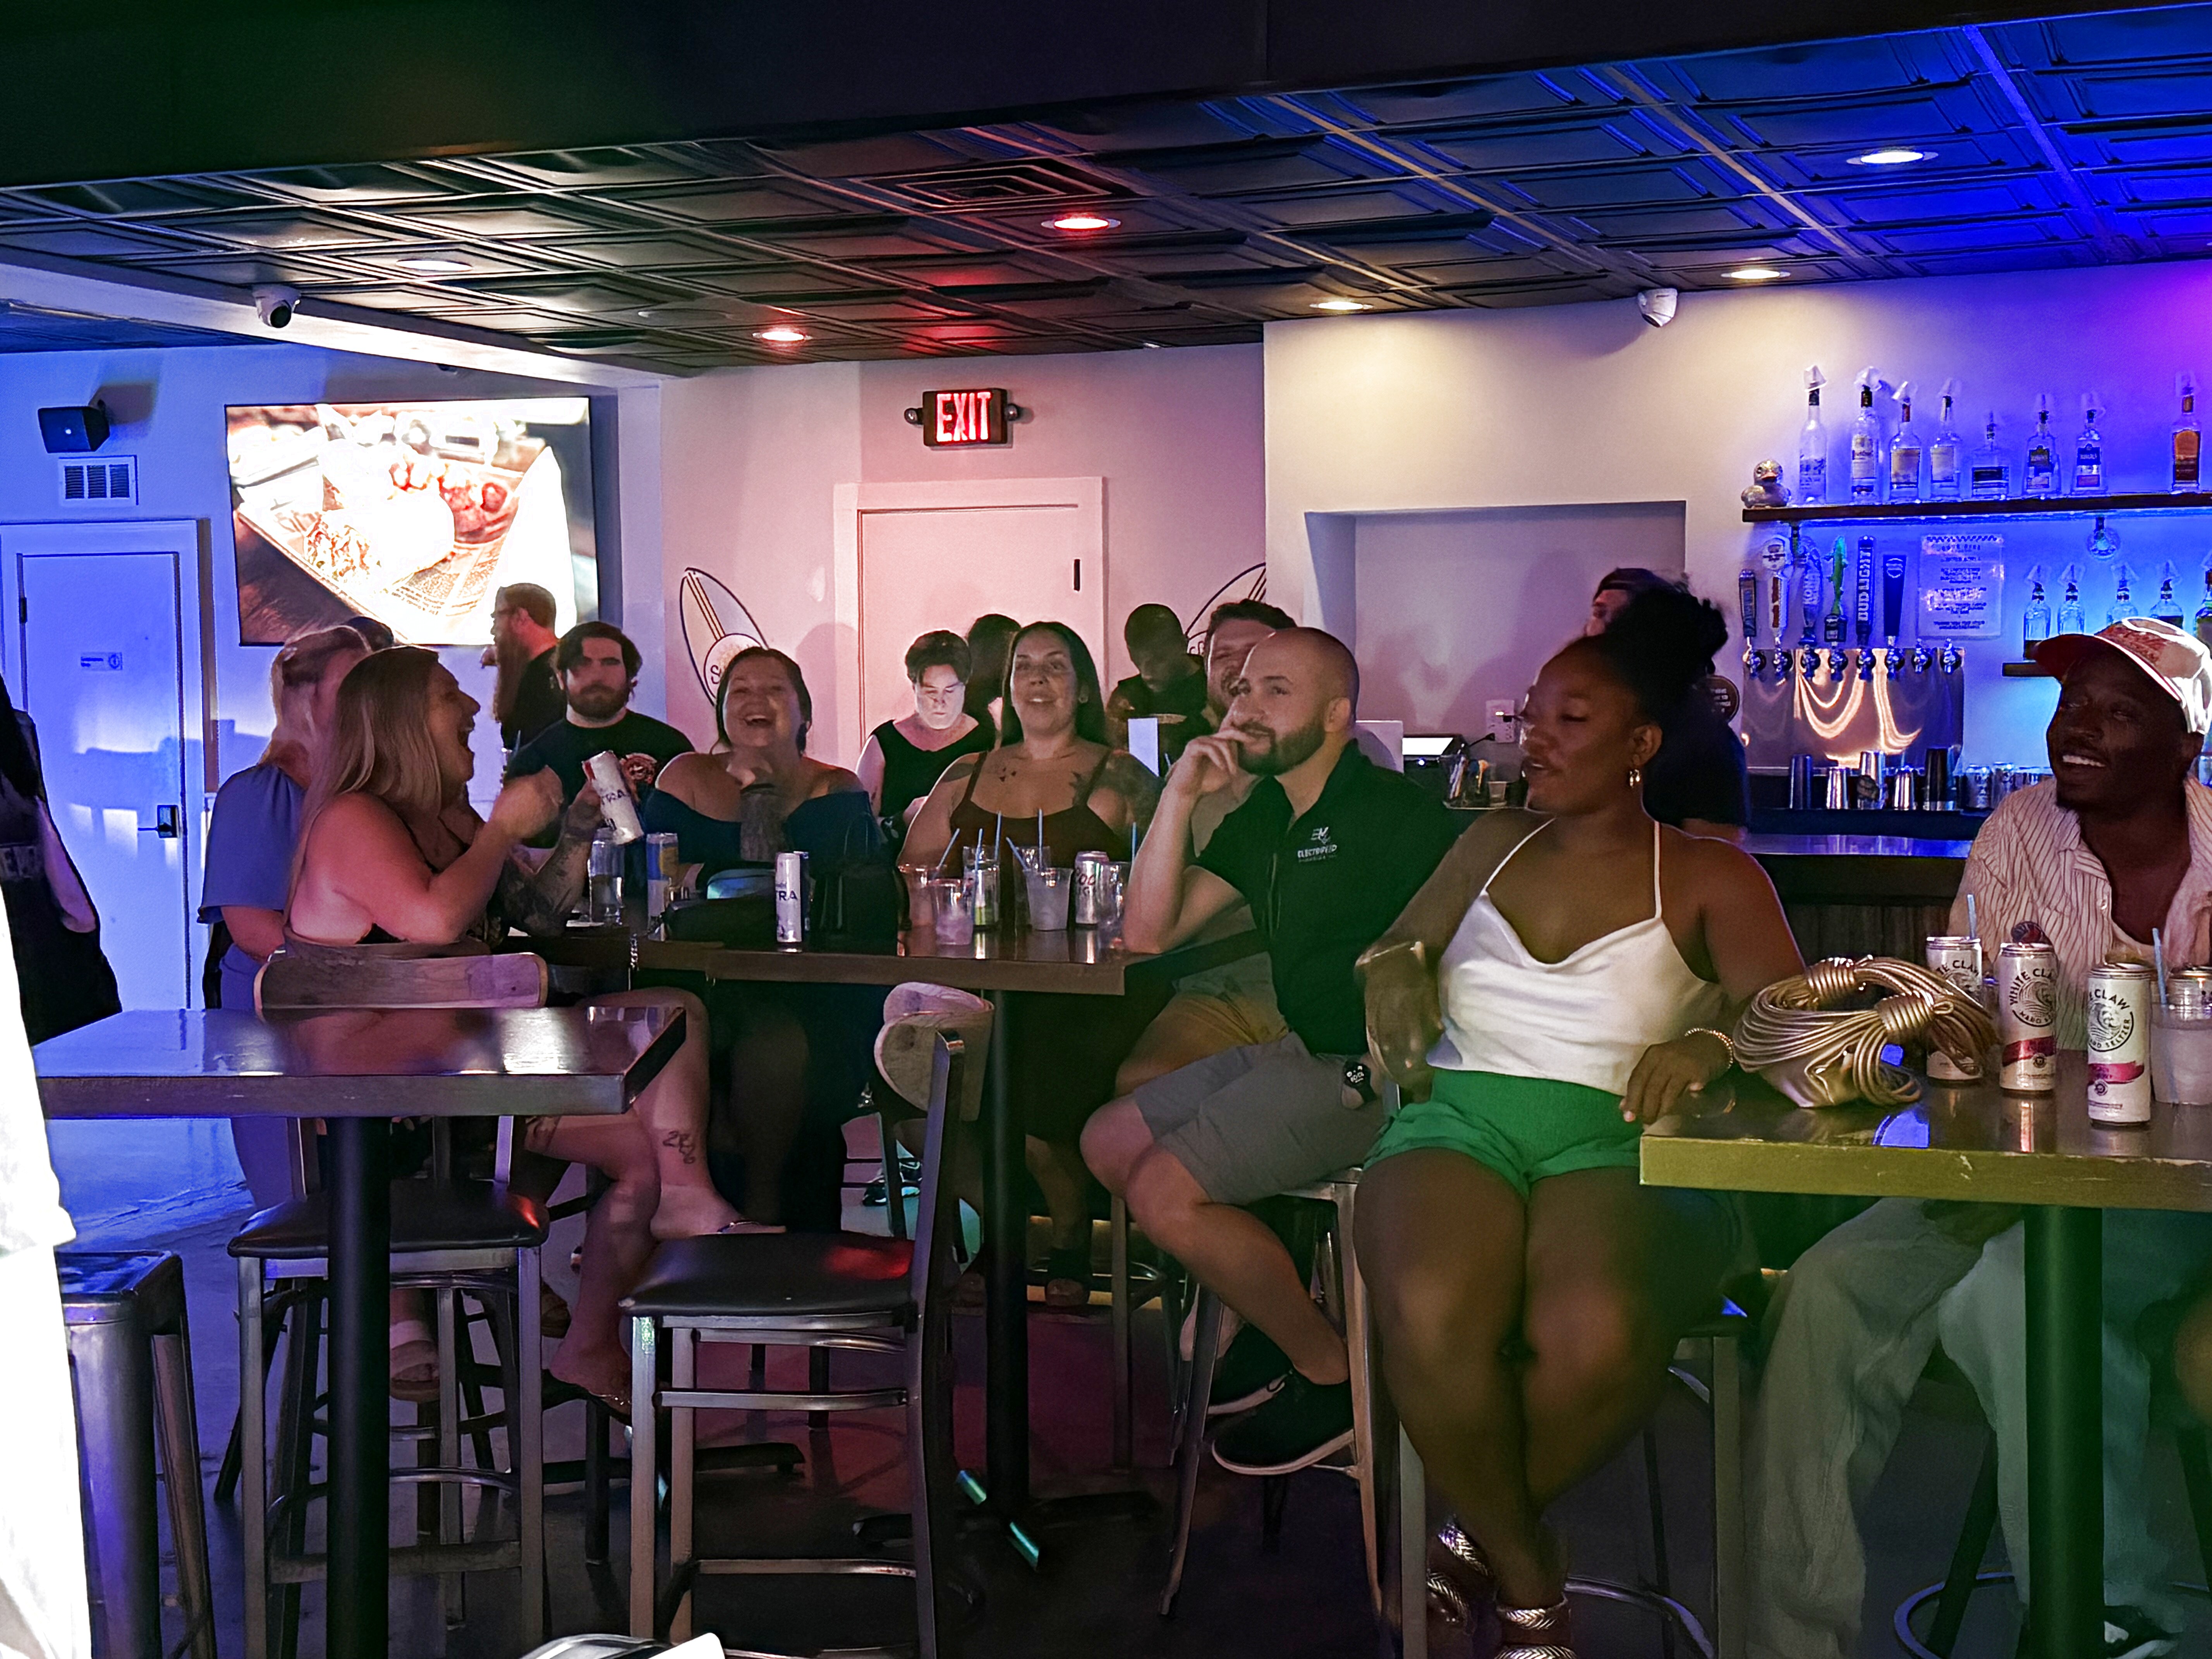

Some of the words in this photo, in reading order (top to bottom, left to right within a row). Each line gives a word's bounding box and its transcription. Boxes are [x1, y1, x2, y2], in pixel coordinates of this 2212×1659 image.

[936, 392, 992, 441] EXIT
[1858, 550, 1871, 590] LIGHT
[1858, 591, 1870, 621] BUD
[600, 789, 626, 805] TRA
[2009, 971, 2030, 1005] WHITE
[2094, 989, 2130, 1010] CLAW
[2105, 1019, 2130, 1048] SELTZER
